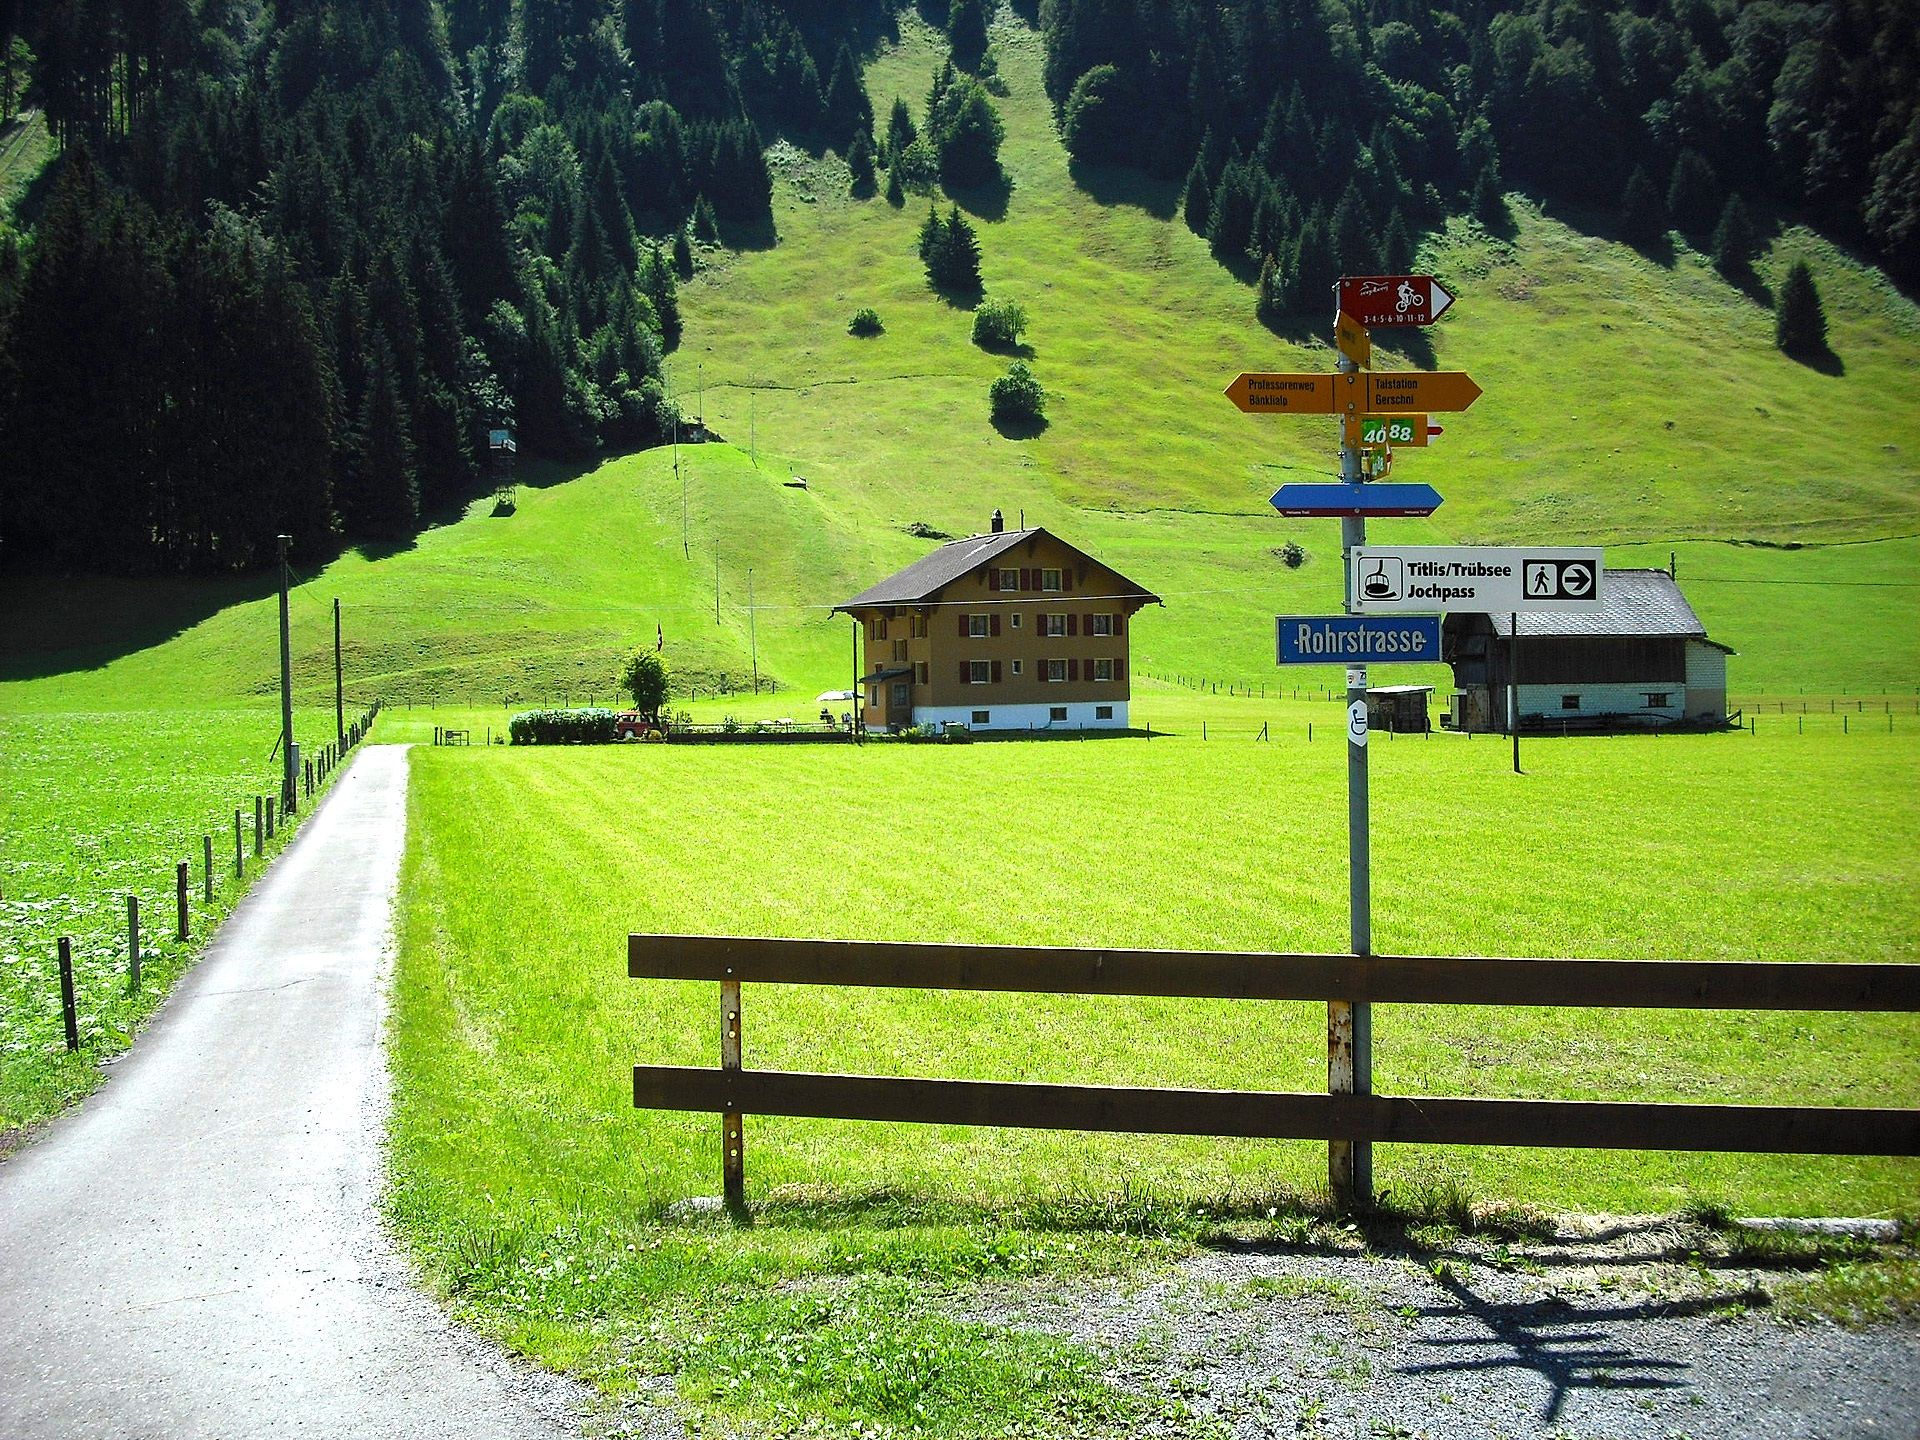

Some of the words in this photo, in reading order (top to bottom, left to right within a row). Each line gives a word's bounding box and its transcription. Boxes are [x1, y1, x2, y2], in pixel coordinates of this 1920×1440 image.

[1248, 379, 1315, 392] Professorenweg
[1375, 378, 1418, 389] Talstation
[1375, 394, 1414, 405] Gerschni
[1363, 429, 1387, 444] 40
[1389, 424, 1411, 442] 88
[1407, 562, 1512, 577] Titlis/Trübsee
[1407, 584, 1475, 602] Jochpass
[1298, 623, 1423, 654] Rohrstrasse
